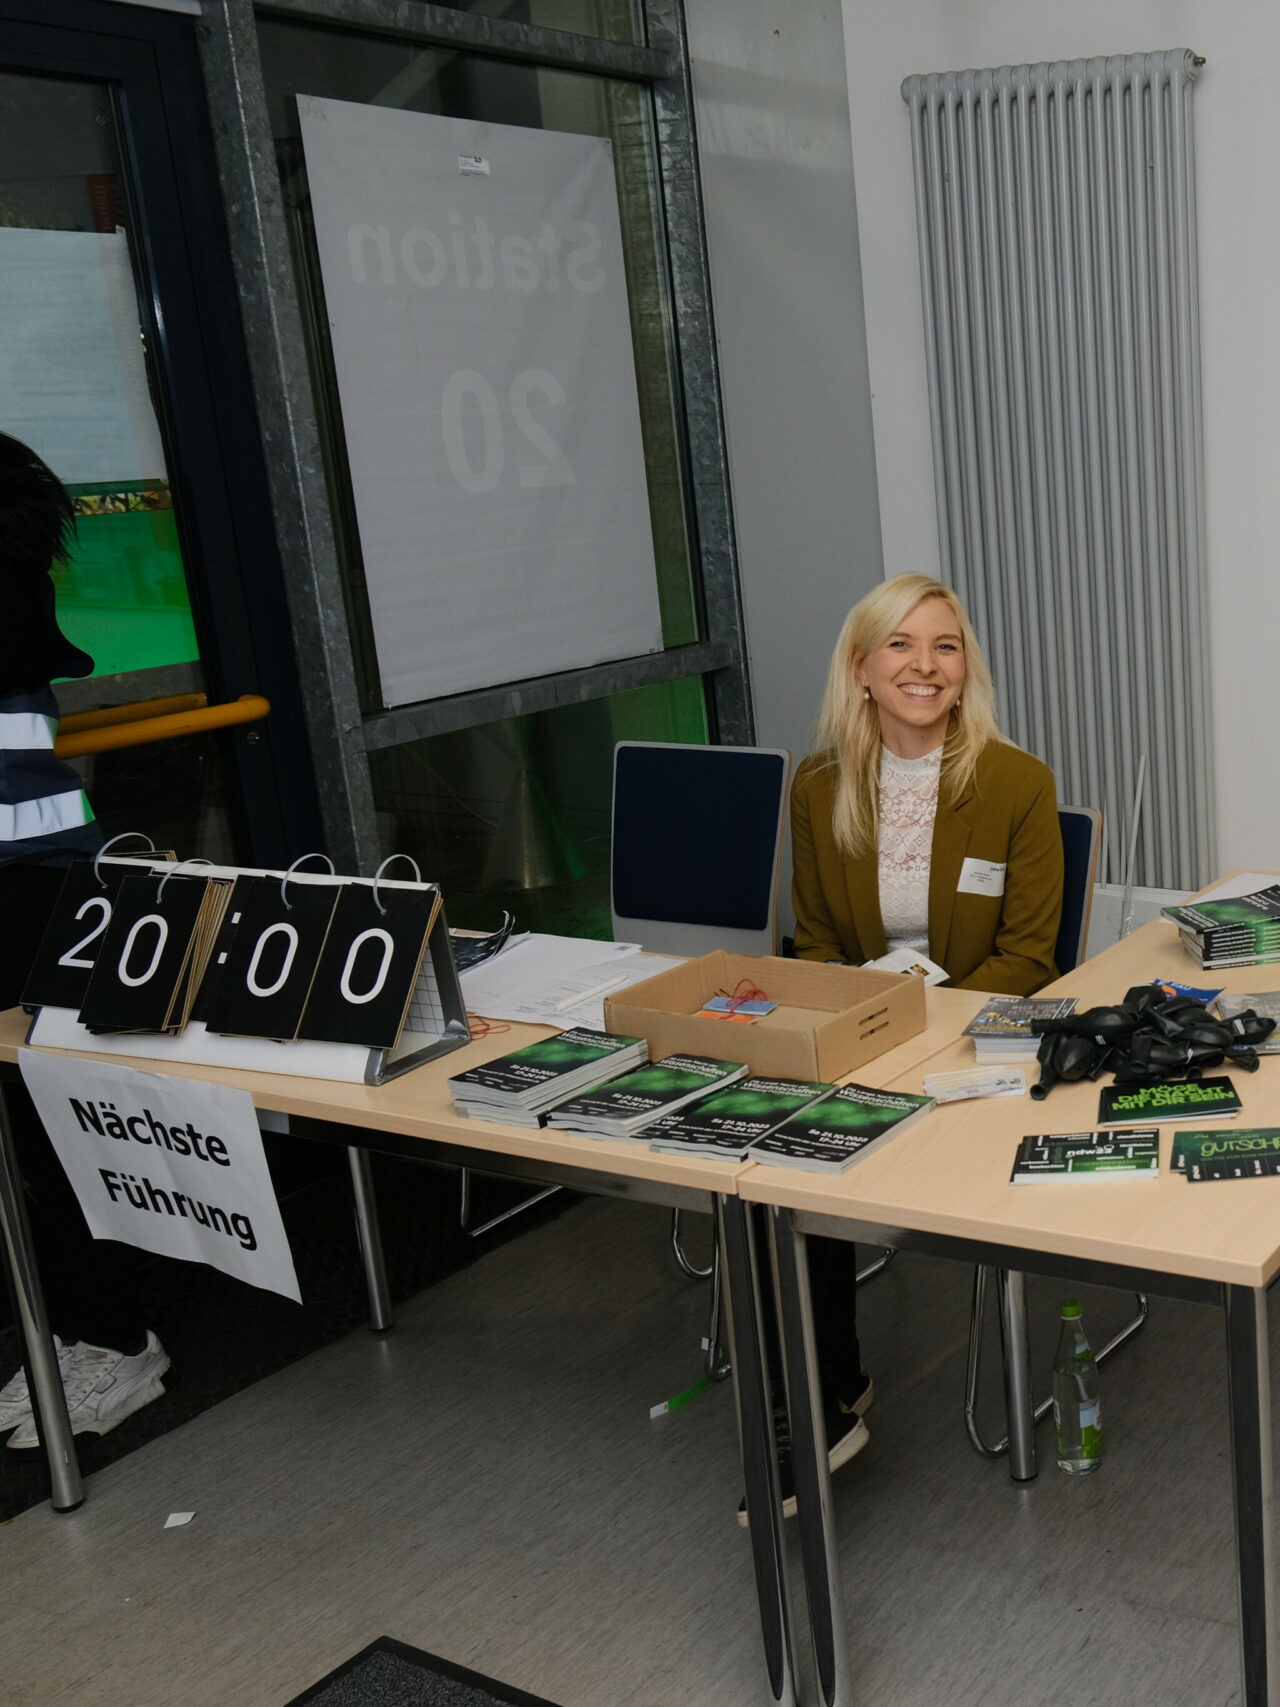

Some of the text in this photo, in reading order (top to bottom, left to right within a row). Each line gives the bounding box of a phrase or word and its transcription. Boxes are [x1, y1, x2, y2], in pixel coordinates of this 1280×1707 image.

[839, 1088, 920, 1108] Wissenschaften
[1139, 1083, 1200, 1095] MÖGE
[1112, 1091, 1236, 1110] MIT DIR SEIN
[69, 1098, 231, 1166] Nächste
[98, 1168, 257, 1251] Führung
